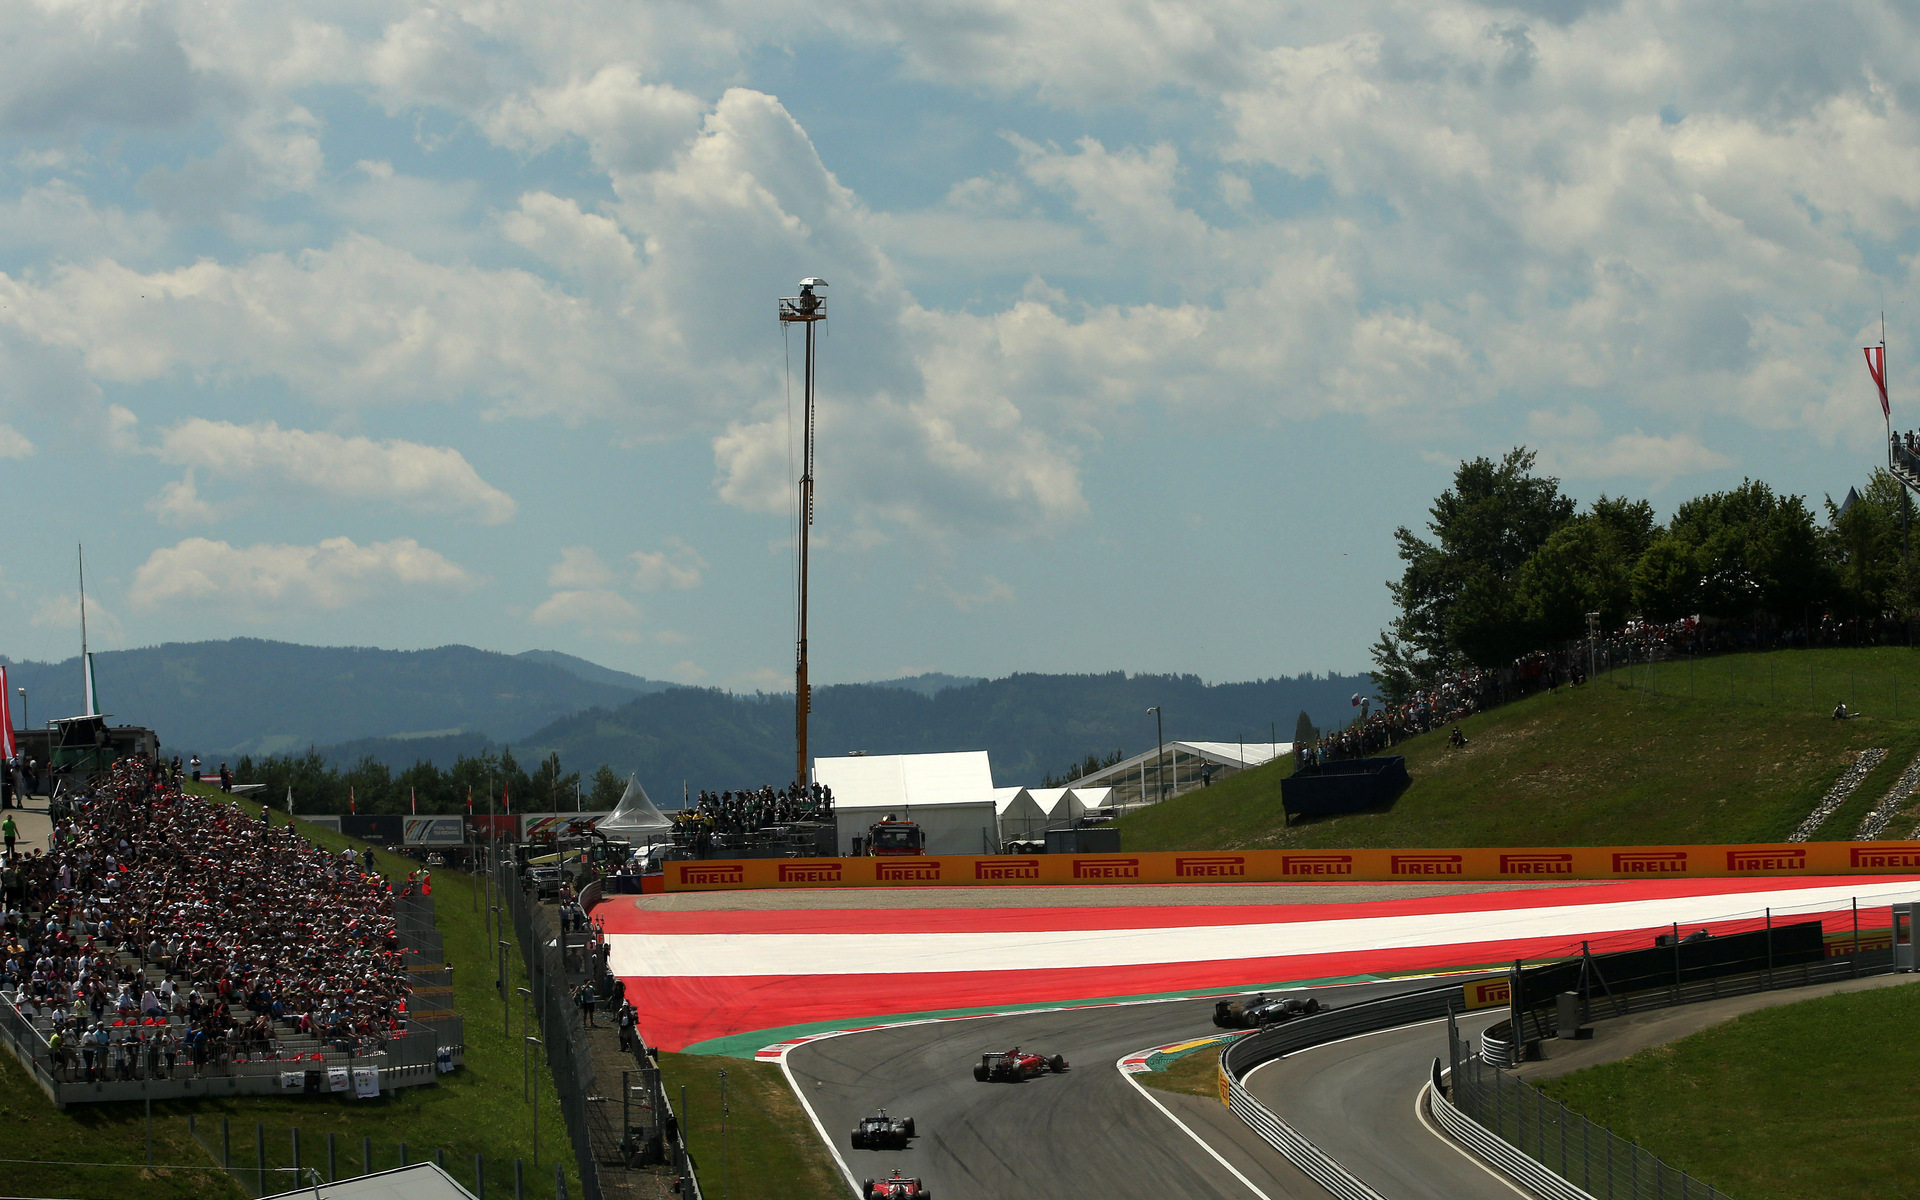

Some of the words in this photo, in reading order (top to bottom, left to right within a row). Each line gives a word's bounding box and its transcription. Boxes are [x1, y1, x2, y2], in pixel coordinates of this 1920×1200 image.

[975, 860, 1039, 879] PIRELLI
[1073, 859, 1139, 878] PIRELLI
[1176, 857, 1244, 877] PIRELLI
[1282, 856, 1352, 875] PIRELLI
[1391, 855, 1462, 875] PIRELLI
[1500, 854, 1572, 874] PIRELLI
[1612, 852, 1687, 873] PIRELLI
[1726, 849, 1806, 871] PIRELLI
[680, 865, 743, 884] PIRELLI
[778, 864, 842, 882] PIRELLI
[876, 862, 940, 881] PIRELLI
